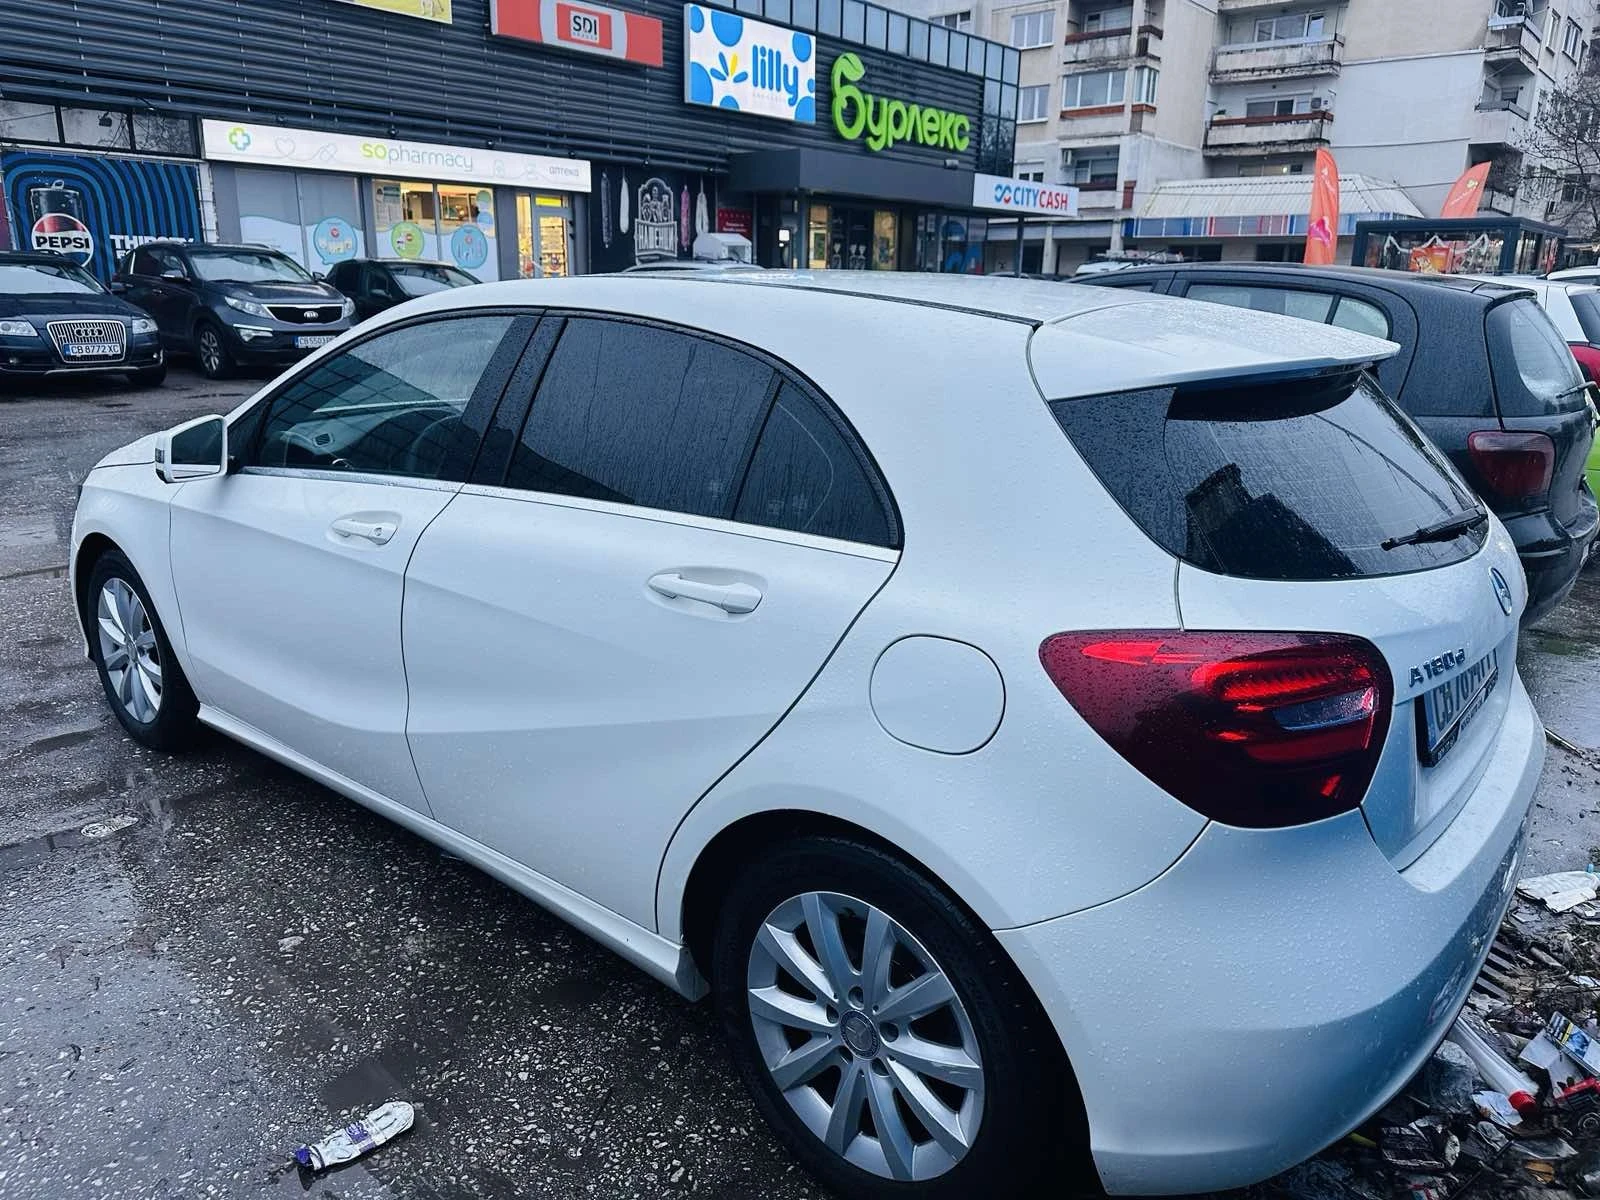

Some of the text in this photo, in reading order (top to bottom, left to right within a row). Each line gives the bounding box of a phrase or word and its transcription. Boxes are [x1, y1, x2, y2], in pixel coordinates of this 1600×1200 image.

[572, 15, 597, 36] SDI
[752, 44, 799, 107] lilly
[362, 143, 473, 172] sopharmacy
[549, 166, 580, 177] аптека
[35, 236, 90, 249] PEPSI
